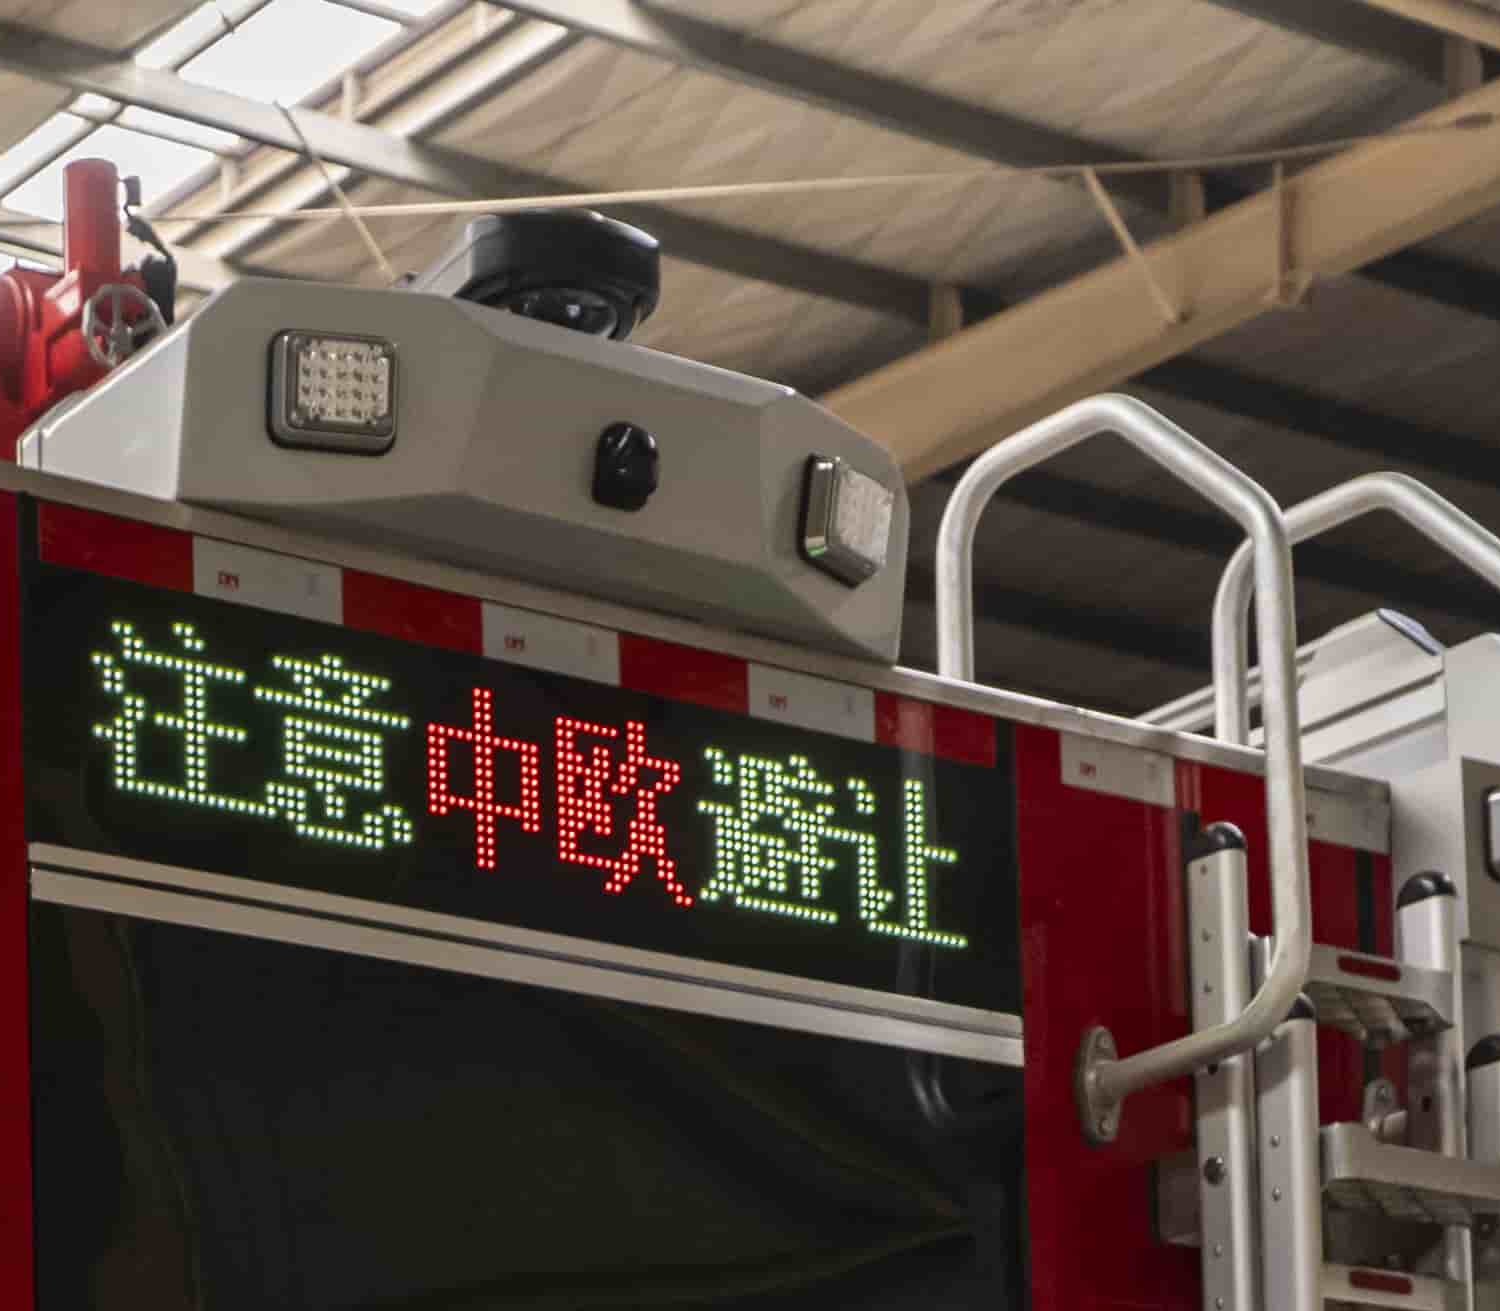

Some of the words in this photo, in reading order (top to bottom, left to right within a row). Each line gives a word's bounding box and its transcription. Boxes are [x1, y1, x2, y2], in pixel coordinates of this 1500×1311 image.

[90, 620, 967, 947] 注意中欧避让
